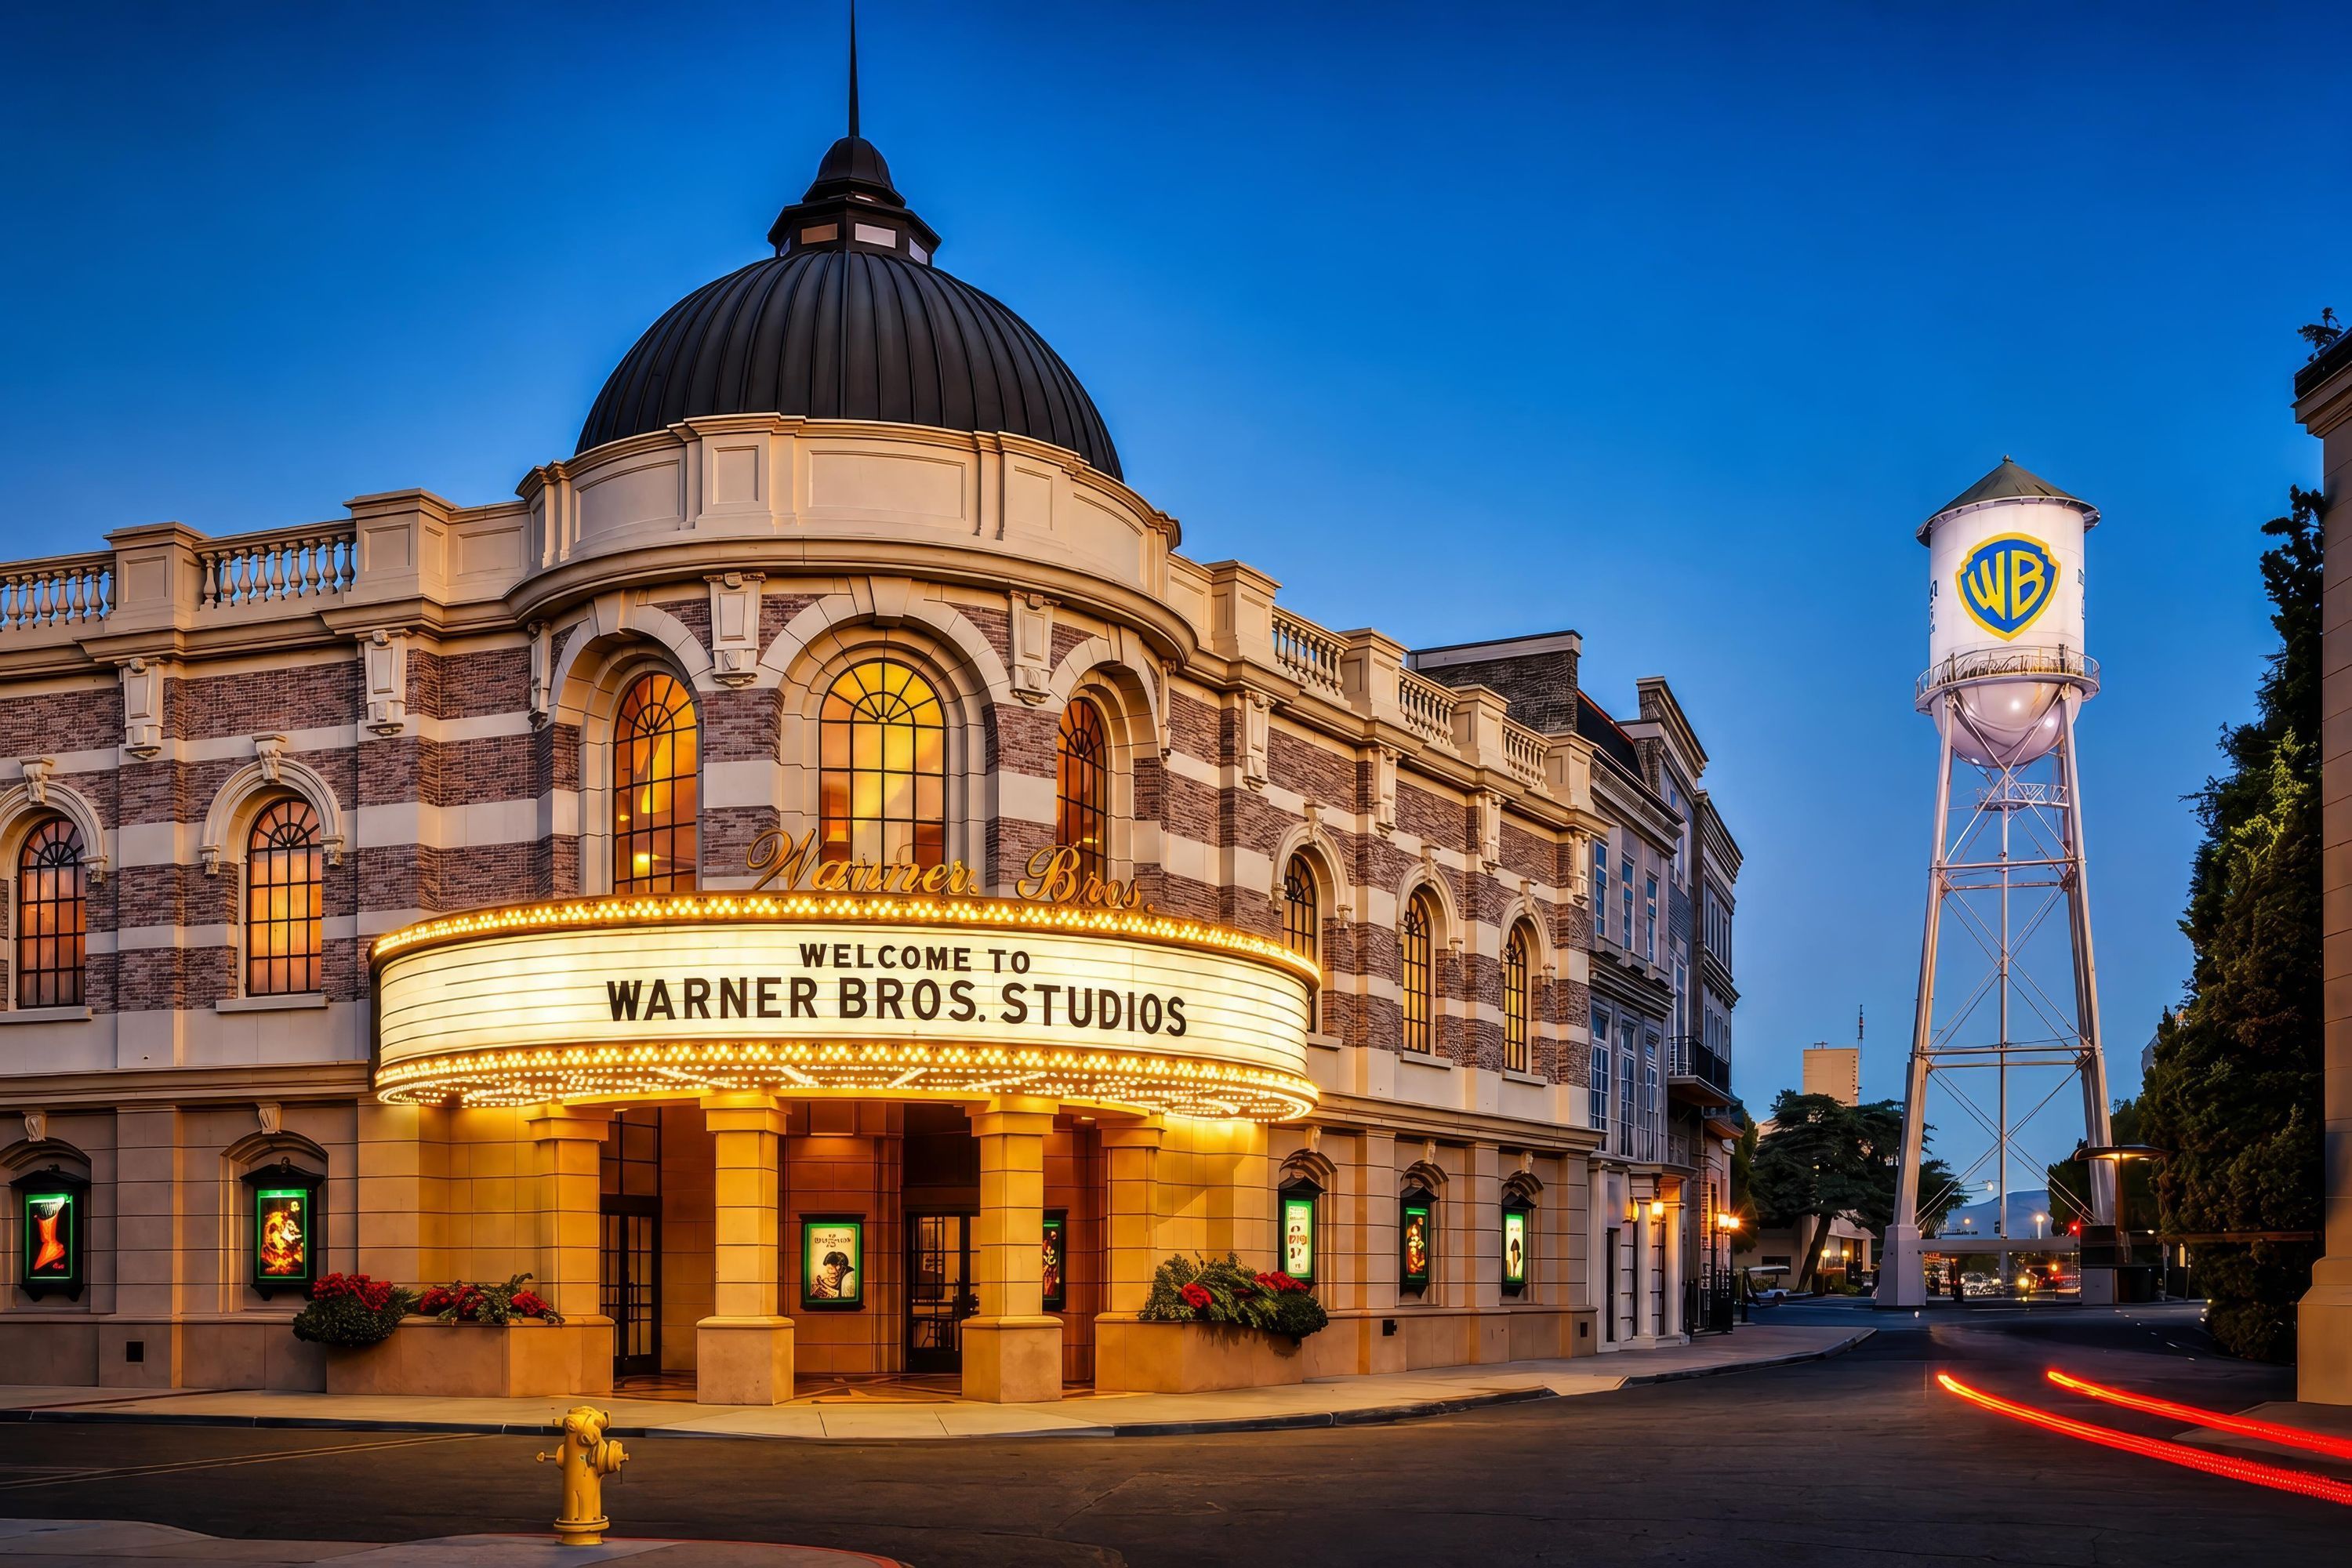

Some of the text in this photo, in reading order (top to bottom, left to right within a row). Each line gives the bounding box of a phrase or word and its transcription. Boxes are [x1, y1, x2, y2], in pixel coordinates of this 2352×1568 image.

[1967, 550, 2046, 621] WB
[799, 943, 1031, 975] WELCOME TO
[606, 977, 1188, 1037] WARNER BROS. STUDIOS
